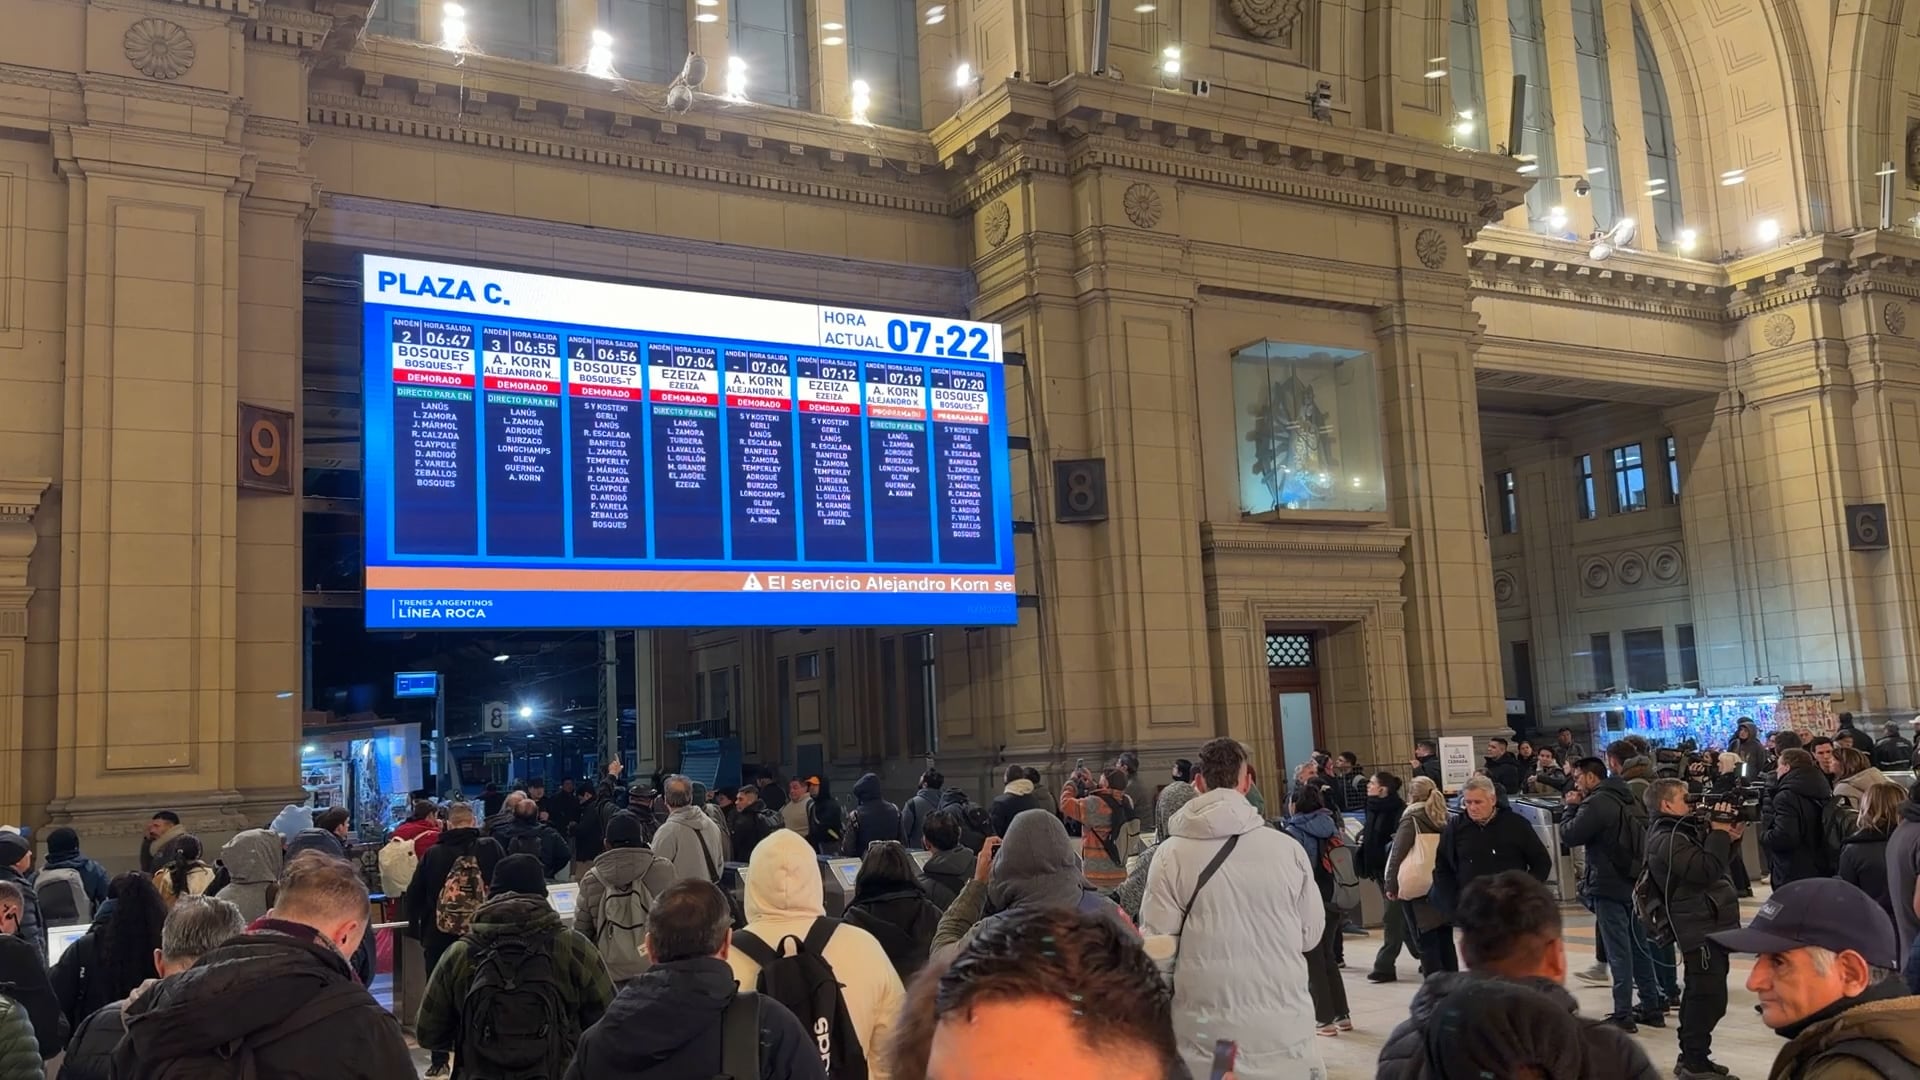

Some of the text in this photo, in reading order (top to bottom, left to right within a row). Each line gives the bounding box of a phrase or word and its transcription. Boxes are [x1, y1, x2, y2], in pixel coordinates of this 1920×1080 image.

[378, 271, 510, 305] PLAZA C.
[824, 311, 866, 327] HORA
[402, 331, 411, 343] 2
[426, 332, 470, 348] 06:47
[825, 332, 884, 348] ACTUAL
[887, 319, 989, 360] 07:22
[492, 340, 500, 351] 3
[515, 341, 556, 355] 06:55
[398, 346, 470, 362] BOSQUES
[576, 348, 585, 359] 4
[598, 349, 637, 362] 06:56
[405, 360, 464, 372] BOSQUES-T
[493, 356, 550, 368] A. KORN
[677, 356, 714, 368] 07:04
[484, 366, 542, 378] ALEJANDRO
[574, 362, 637, 376] BOSQUES
[752, 362, 787, 374] 07:04
[408, 373, 461, 384] DEMORADO
[580, 374, 632, 385] BOSQUES-T
[662, 369, 706, 381] EZEIZA
[822, 368, 856, 380] 07:12
[890, 373, 921, 385] 07:19
[497, 381, 548, 391] DEMORADO
[669, 382, 699, 390] EZEIZA
[734, 375, 782, 387] A. KORN
[809, 381, 848, 392] EZEIZA
[954, 378, 984, 390] 07:20
[397, 388, 433, 397] DIRECTO
[582, 387, 630, 398] DEMORADO
[726, 386, 775, 395] ALEJANDRO
[873, 386, 918, 397] A. KORN
[936, 390, 984, 402] BOSQUES
[488, 395, 521, 403] DIRECTO
[523, 397, 543, 405] PARA
[662, 393, 707, 403] DEMORADO
[738, 399, 781, 408] DEMORADO
[867, 396, 912, 405] ALEJANDRO
[421, 402, 448, 411] LANÚS
[654, 407, 683, 415] DIRECTO
[809, 404, 850, 413] DEMORADO
[940, 402, 980, 410] BOSQUES-T
[422, 412, 457, 420] ZAMORA
[510, 408, 536, 417] LANÚS
[422, 421, 458, 430] MÁRMOL
[512, 418, 544, 426] ZAMORA
[595, 421, 619, 429] LANÚS
[422, 431, 459, 440] CALZADA
[505, 427, 542, 435] ADROGUÉ
[593, 430, 631, 439] ESCALADA
[415, 440, 456, 449] CLAYPOLE
[506, 436, 542, 445] BURZACO
[589, 439, 626, 448] BANFIELD
[251, 420, 280, 476] 9
[498, 445, 551, 454] LONGCHAMPS
[586, 457, 630, 465] TEMPERLEY
[415, 469, 456, 478] ZEBALLOS
[505, 464, 544, 472] GUERNICA
[596, 466, 628, 474] MÁRMOL
[417, 479, 455, 487] BOSQUES
[1069, 470, 1095, 511] 8
[1856, 511, 1878, 542] 6
[768, 576, 1012, 592] El servicio Alejandro Korn se
[399, 607, 486, 618] LÍNEA ROCA
[491, 708, 502, 728] 8
